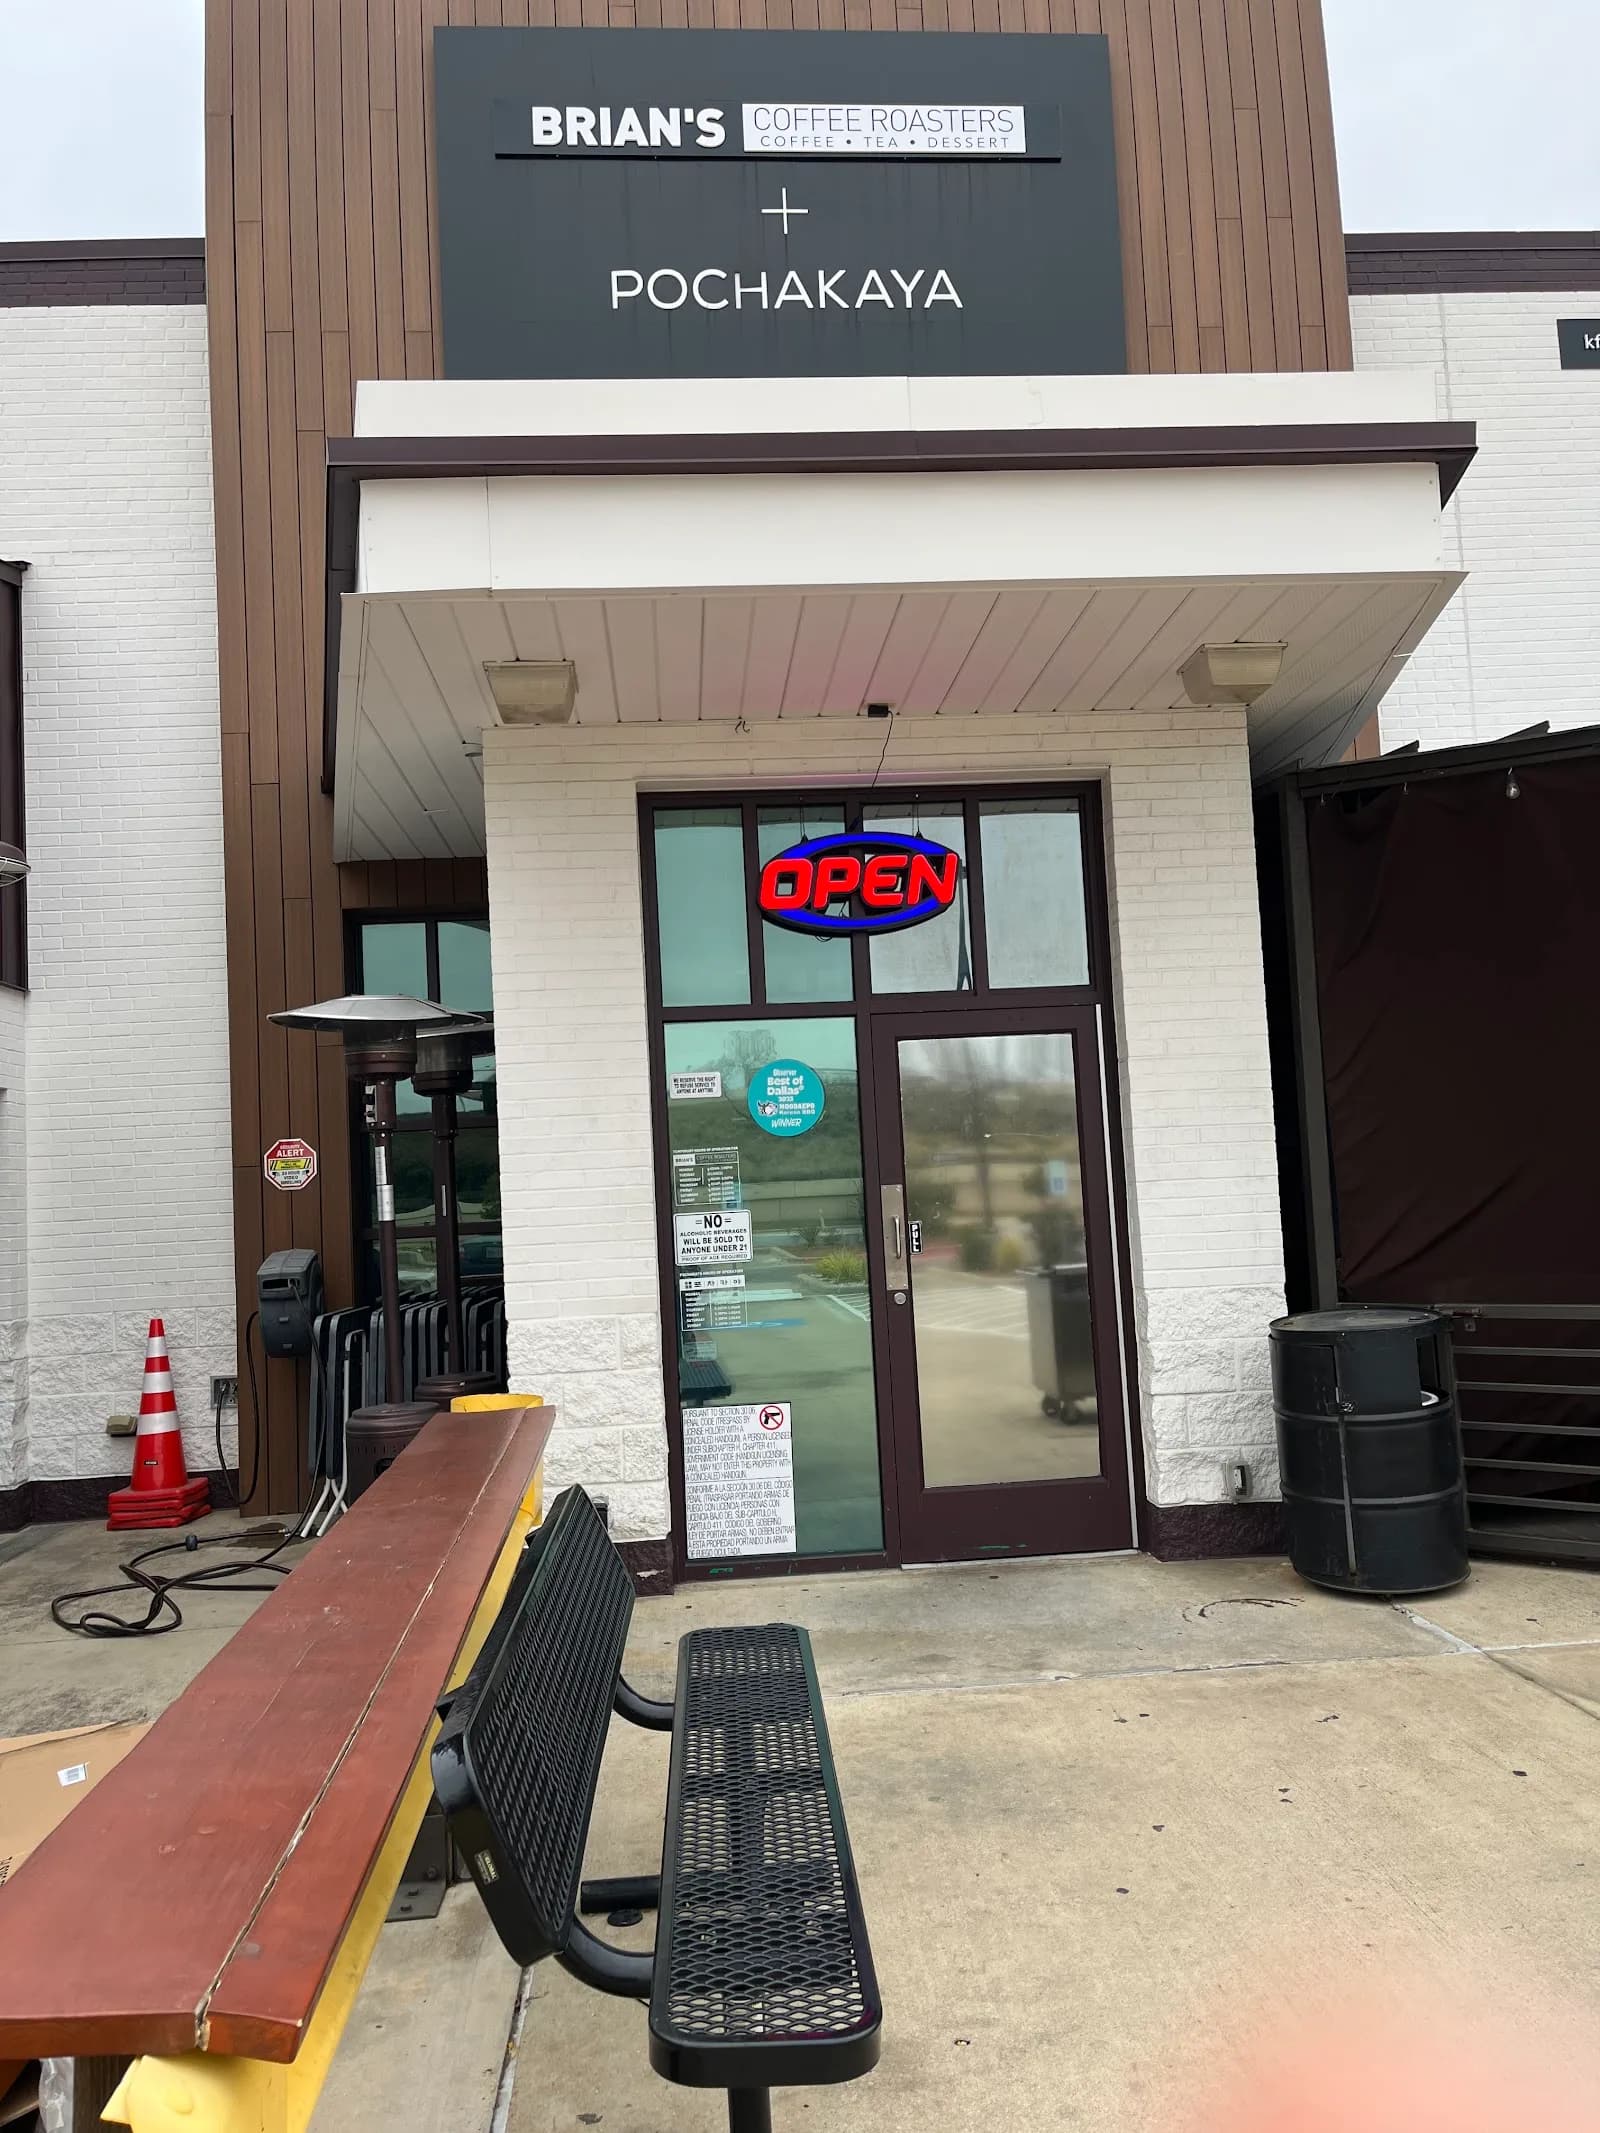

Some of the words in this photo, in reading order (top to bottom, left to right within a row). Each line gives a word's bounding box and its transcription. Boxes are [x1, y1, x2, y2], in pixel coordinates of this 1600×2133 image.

[754, 108, 862, 131] COFFEE
[872, 108, 1014, 132] ROASTERS
[532, 106, 726, 148] BRIAN'S
[761, 136, 833, 147] COFFEE
[864, 136, 898, 147] TEA
[928, 137, 1009, 148] DESSERT
[611, 268, 964, 309] POCHAKAYA
[760, 853, 958, 910] OPEN
[768, 1077, 790, 1086] Best
[792, 1076, 804, 1085] of
[771, 1119, 802, 1128] WINNER
[276, 1149, 304, 1158] ALERT
[704, 1215, 722, 1228] NO
[682, 1246, 711, 1254] ANYONE
[719, 1407, 740, 1416] SECTION
[701, 1418, 714, 1426] CODE
[720, 1453, 734, 1461] CODE
